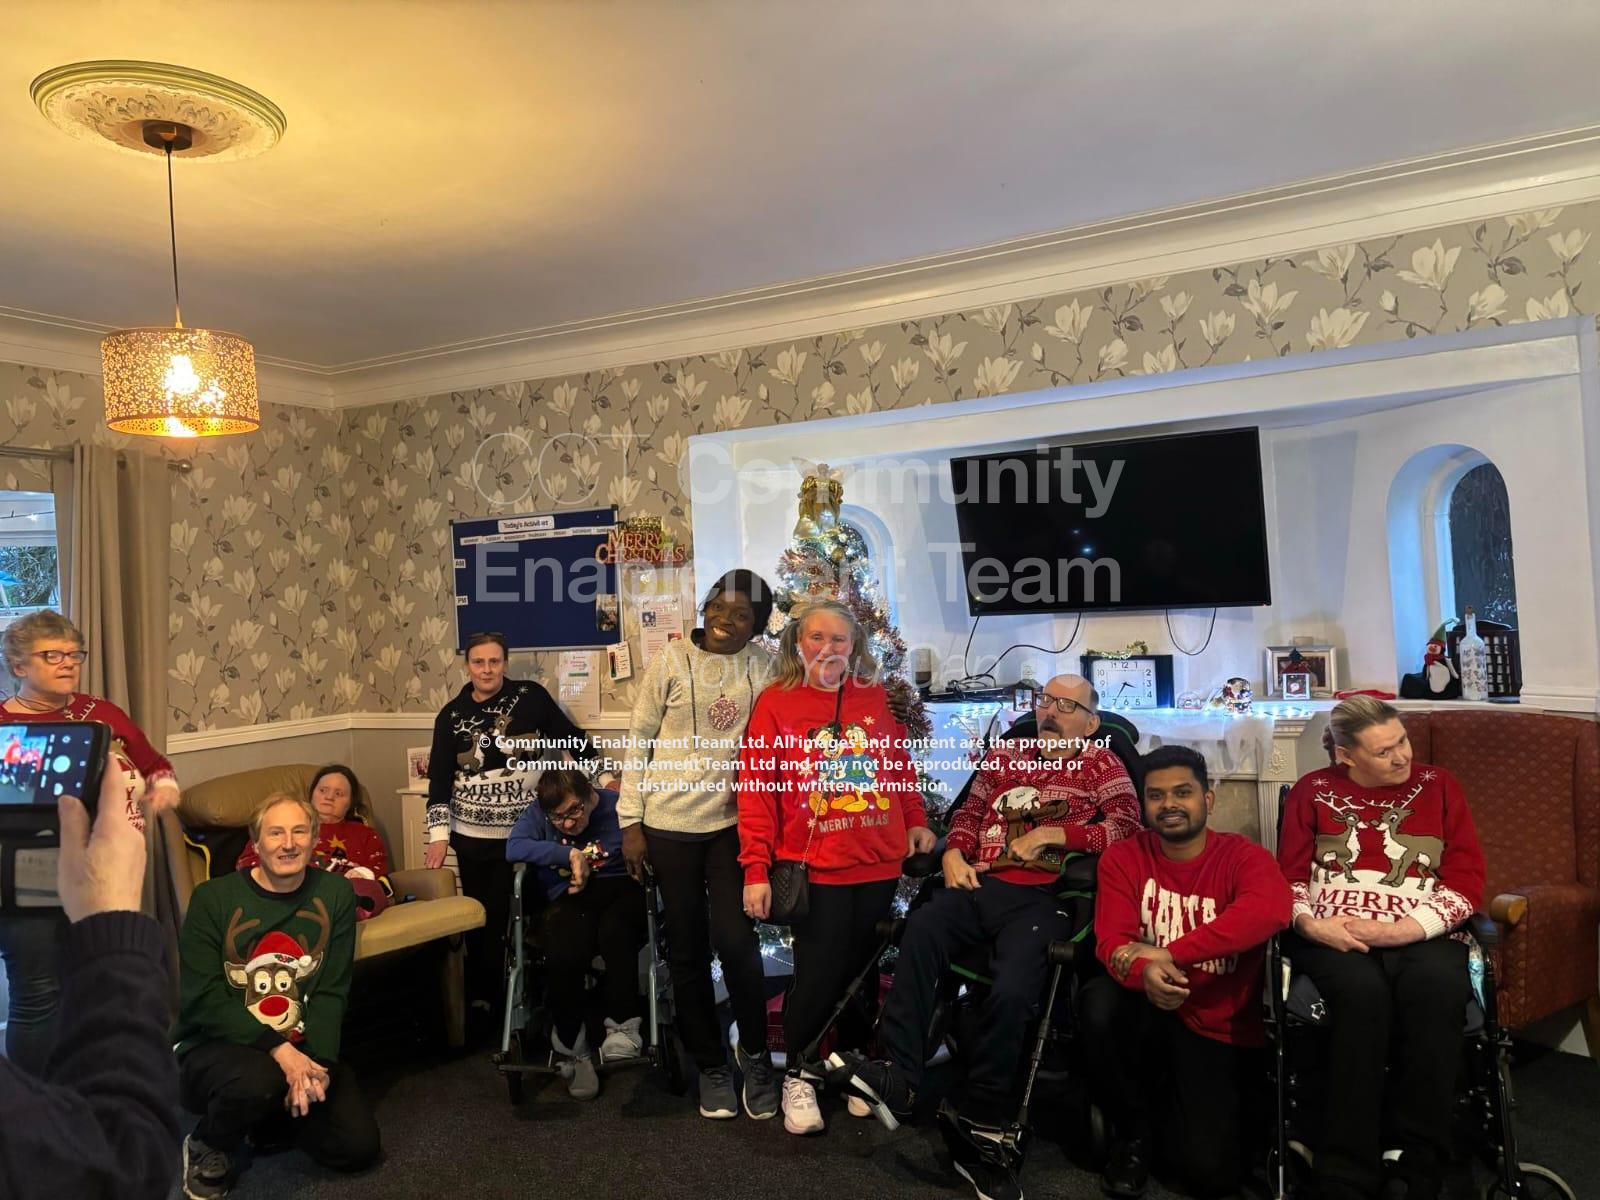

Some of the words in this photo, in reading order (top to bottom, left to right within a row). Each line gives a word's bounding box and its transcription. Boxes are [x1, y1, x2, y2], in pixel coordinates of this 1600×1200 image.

[607, 528, 663, 549] MERRY
[595, 544, 685, 564] CHRISTMAS
[462, 778, 525, 796] MERRY
[819, 816, 855, 833] MERRY
[860, 813, 888, 828] XMAS
[1317, 888, 1419, 914] MERRY
[1140, 878, 1217, 948] SANTA
